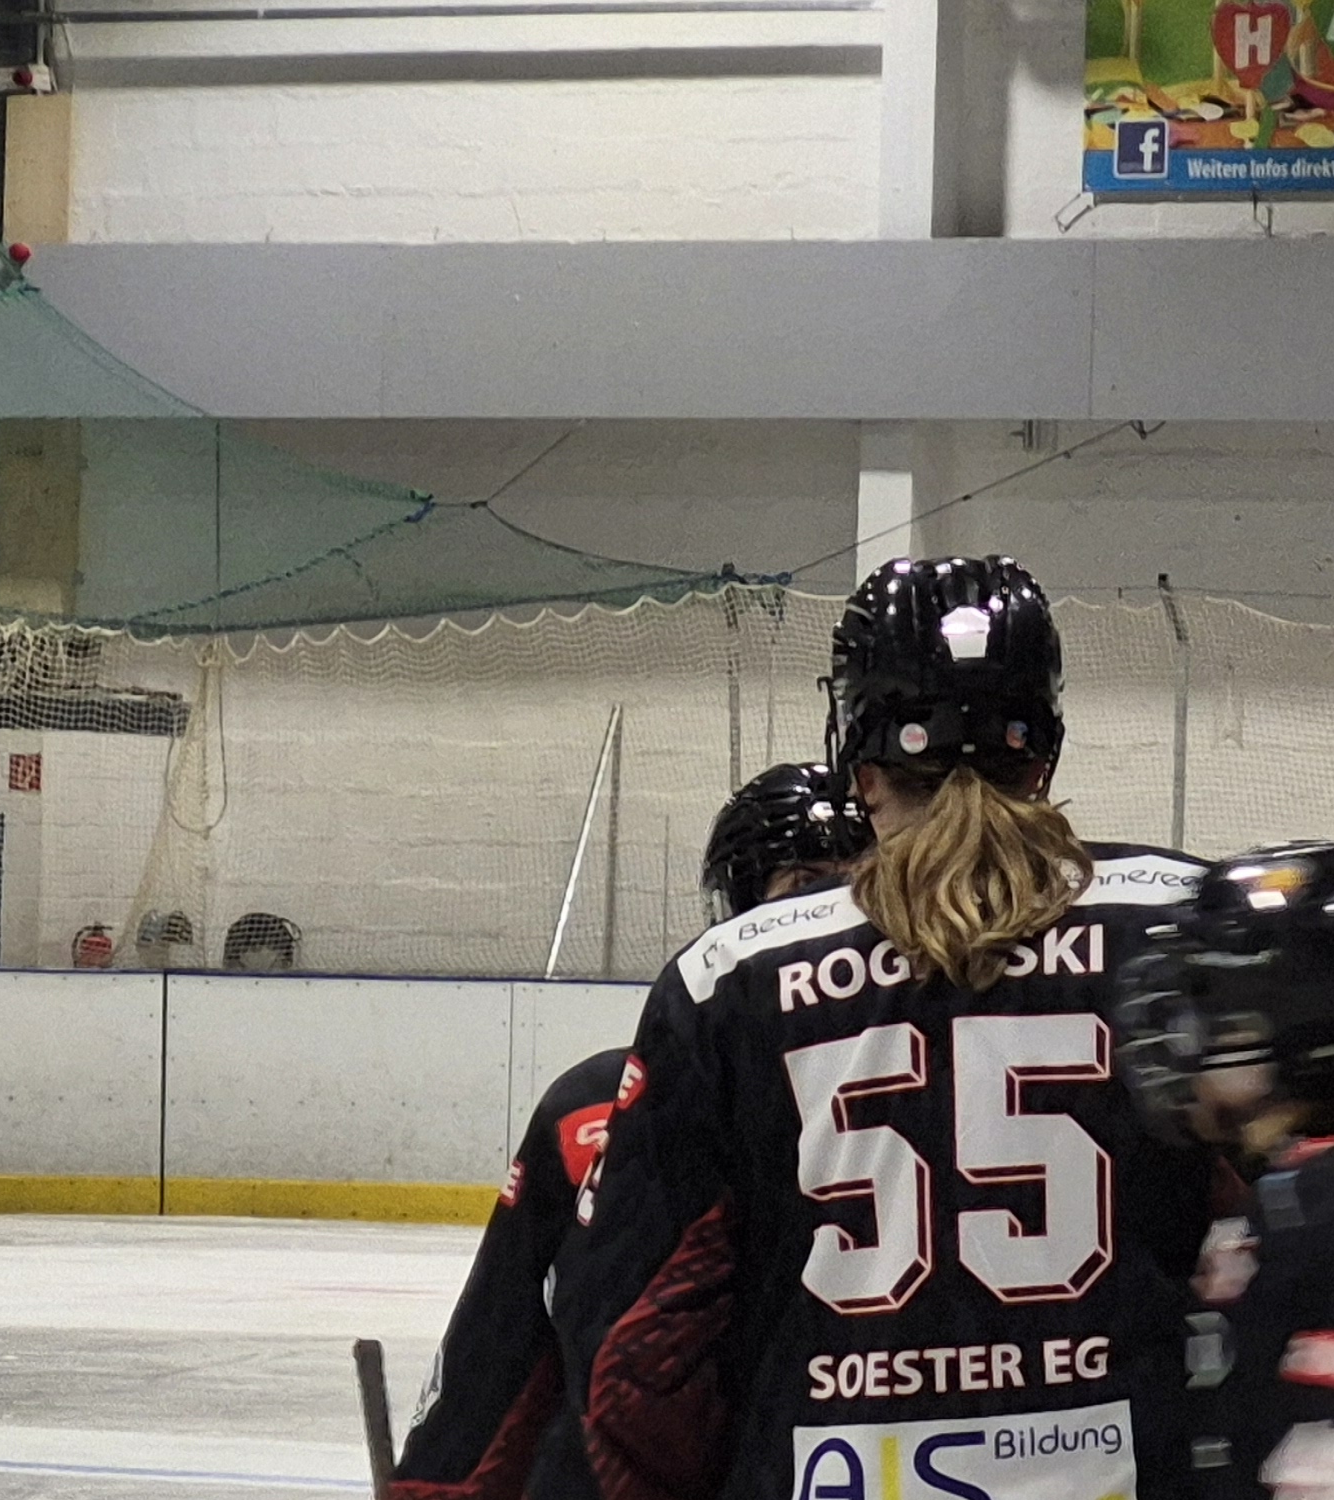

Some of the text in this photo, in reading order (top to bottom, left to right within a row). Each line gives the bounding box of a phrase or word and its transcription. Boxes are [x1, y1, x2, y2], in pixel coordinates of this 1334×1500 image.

[1188, 158, 1246, 179] Weitere
[1250, 158, 1288, 178] Infos
[738, 901, 840, 942] Becker
[778, 923, 1105, 1012] ROGSKI
[784, 1012, 1112, 1315] 55
[807, 1336, 1111, 1400] SOESTER EG
[994, 1423, 1123, 1460] Bildung
